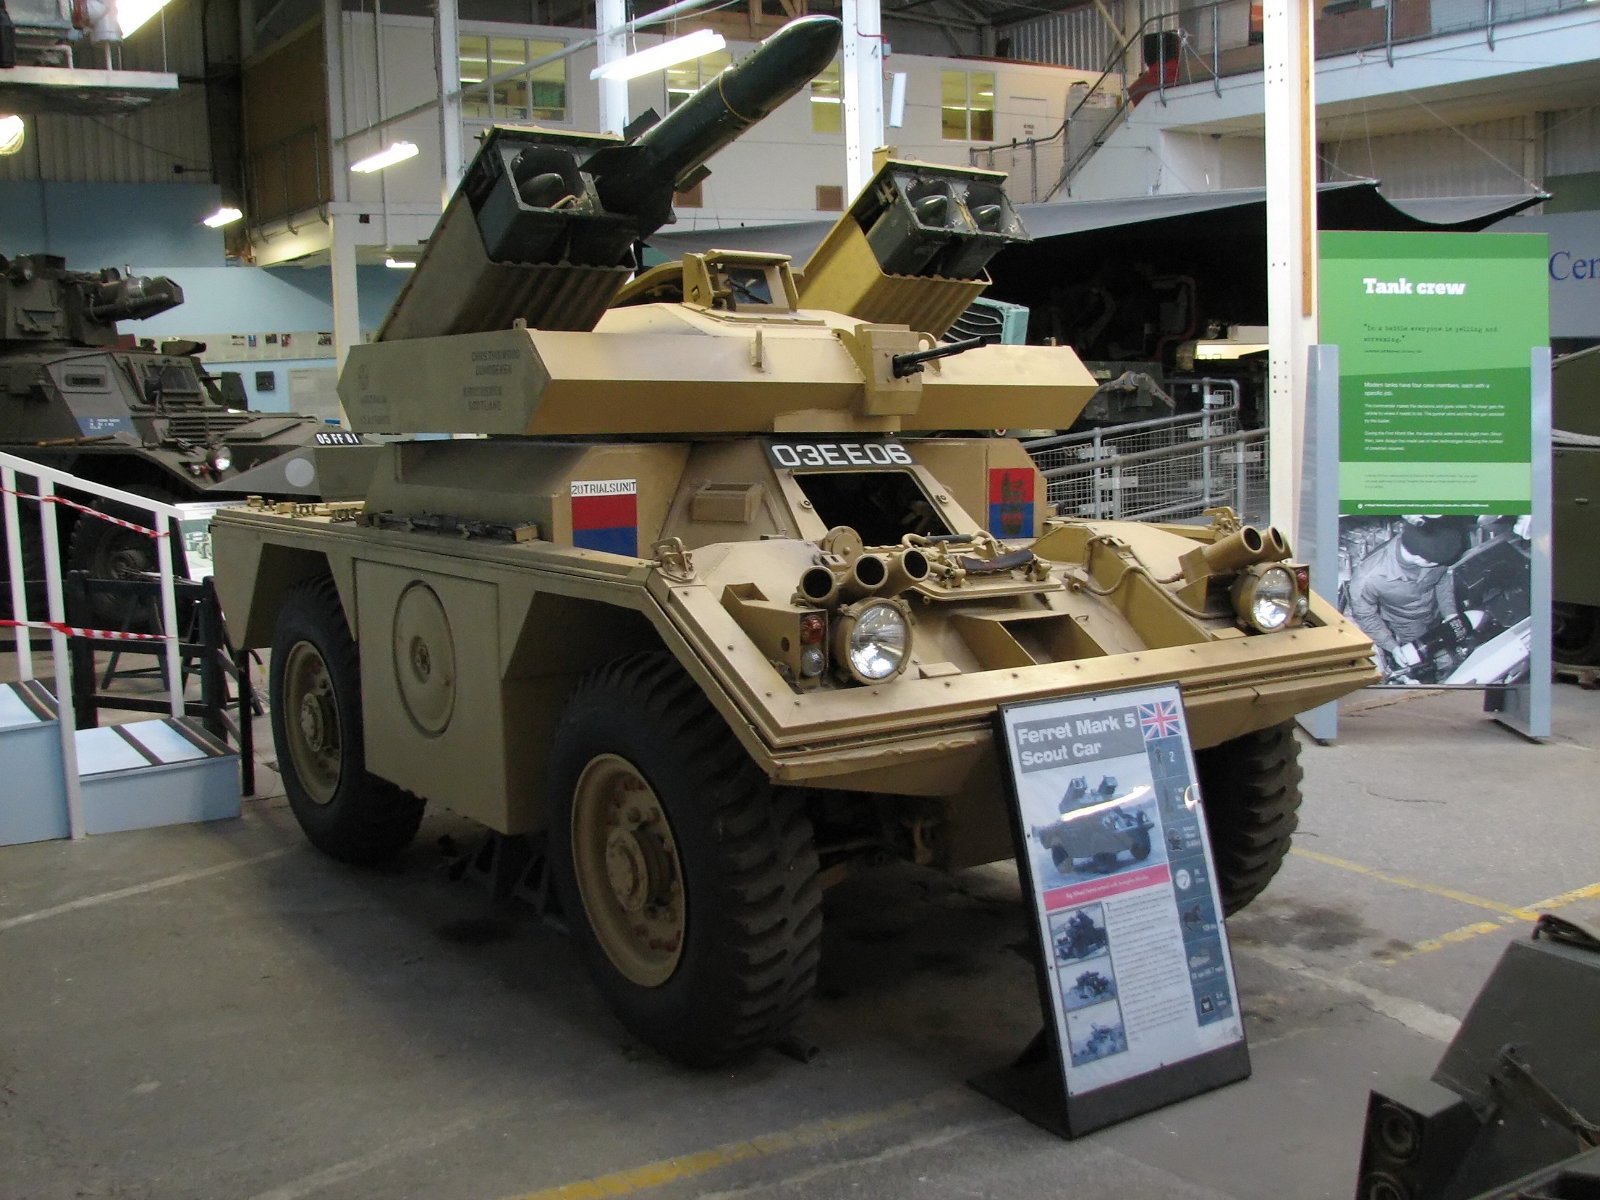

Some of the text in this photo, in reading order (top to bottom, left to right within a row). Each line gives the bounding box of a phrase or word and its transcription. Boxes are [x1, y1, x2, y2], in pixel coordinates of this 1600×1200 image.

[1362, 277, 1466, 295] Tank crew
[1410, 326, 1442, 334] everyone
[1455, 325, 1483, 334] yelling
[315, 433, 332, 445] 05
[329, 433, 345, 445] FF
[771, 443, 912, 467] 03EE06
[1017, 712, 1137, 745] Ferret Mark 5
[1020, 742, 1102, 767] Scout Car
[1168, 750, 1175, 763] 2
